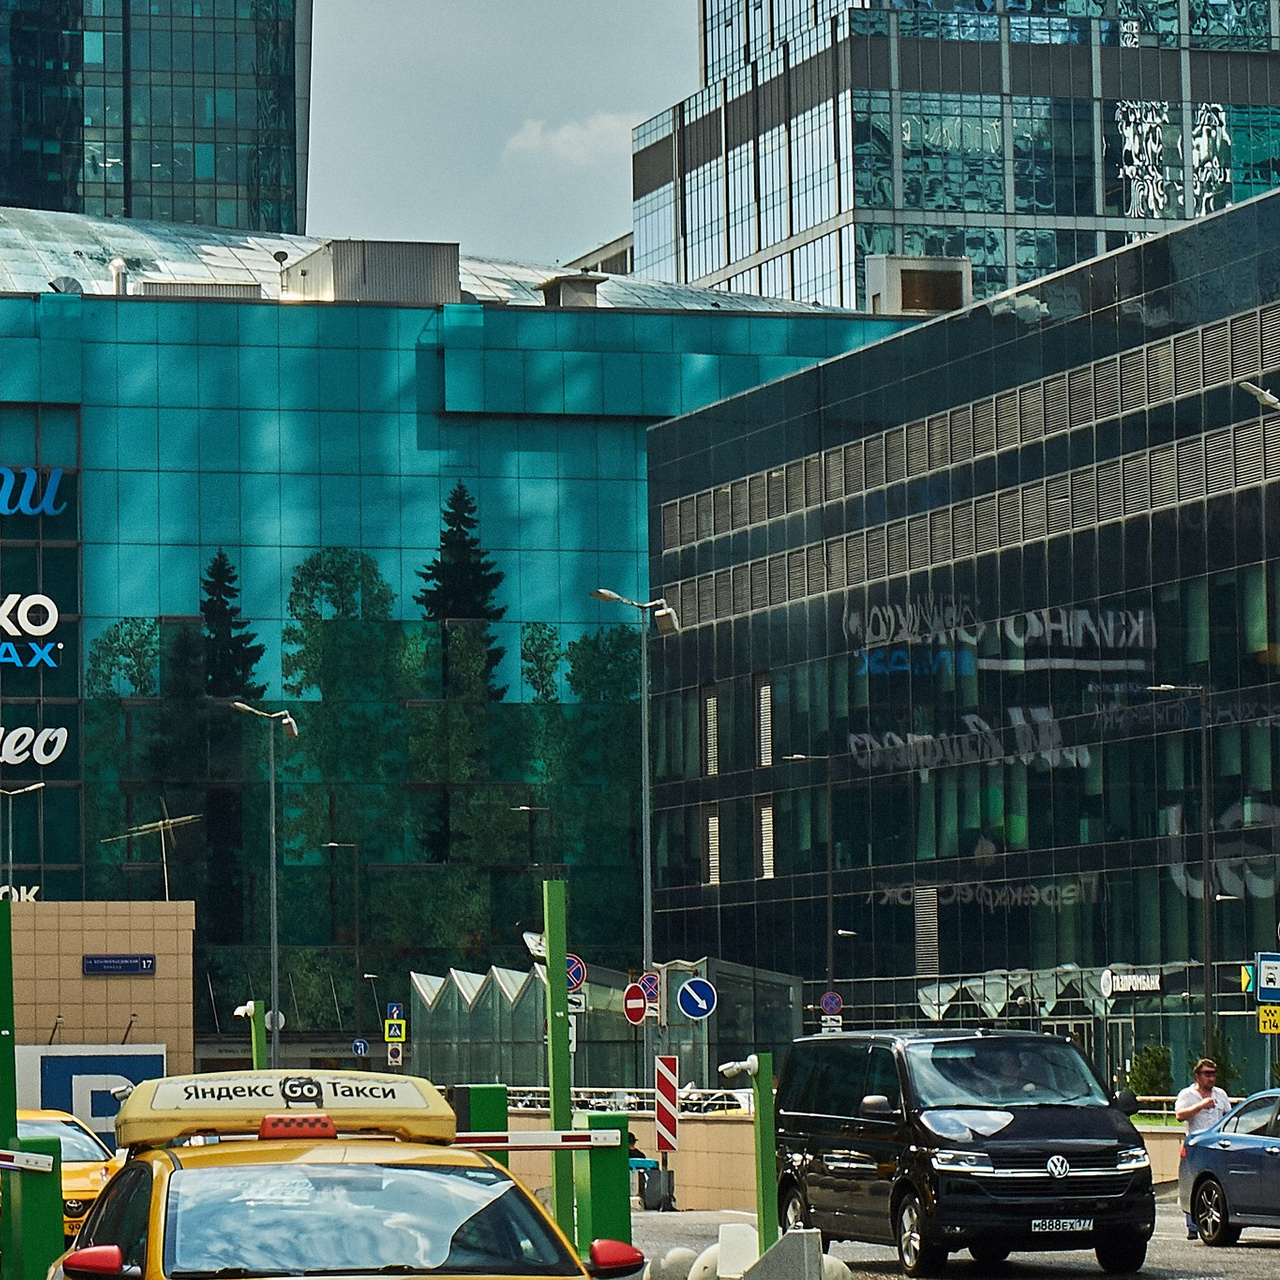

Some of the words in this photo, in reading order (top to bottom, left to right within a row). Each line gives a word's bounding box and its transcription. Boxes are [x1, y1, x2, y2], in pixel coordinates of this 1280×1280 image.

[142, 959, 152, 969] 17
[1112, 974, 1161, 992] ГАЗПРОМБАНК
[183, 1084, 275, 1101] Яндекс
[282, 1078, 321, 1099] Go
[326, 1081, 397, 1100] Такси
